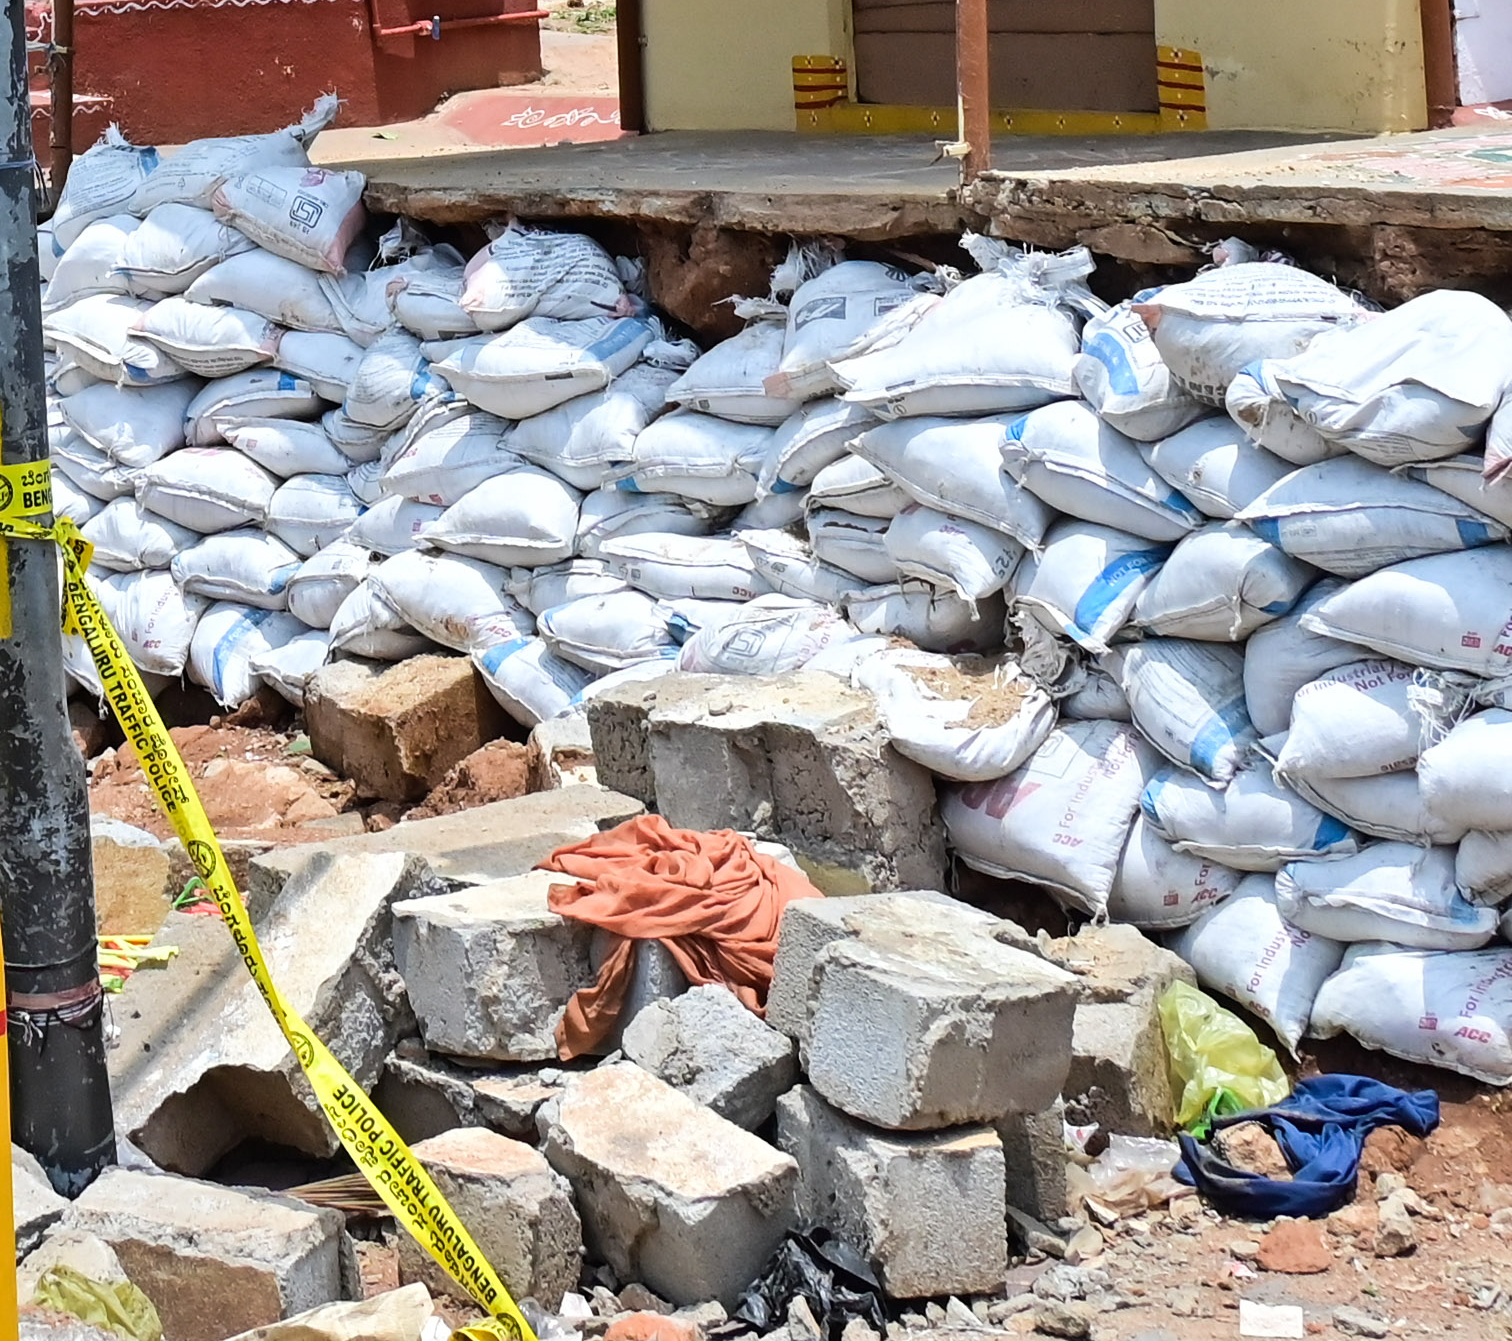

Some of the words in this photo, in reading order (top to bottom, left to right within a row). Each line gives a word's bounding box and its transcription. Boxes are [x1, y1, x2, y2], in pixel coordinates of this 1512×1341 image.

[1355, 673, 1386, 693] Not
[1387, 667, 1412, 686] For
[68, 581, 117, 679] BENGALURU
[109, 682, 149, 751] TRAFFIC
[143, 752, 176, 814] POLICE
[1059, 806, 1077, 828] For
[1247, 972, 1261, 994] For
[1459, 995, 1478, 1019] For
[1454, 1026, 1492, 1044] ACC
[332, 1083, 383, 1143] POLICE
[379, 1139, 430, 1208] TRAFFIC
[428, 1204, 497, 1305] BENGALURU
